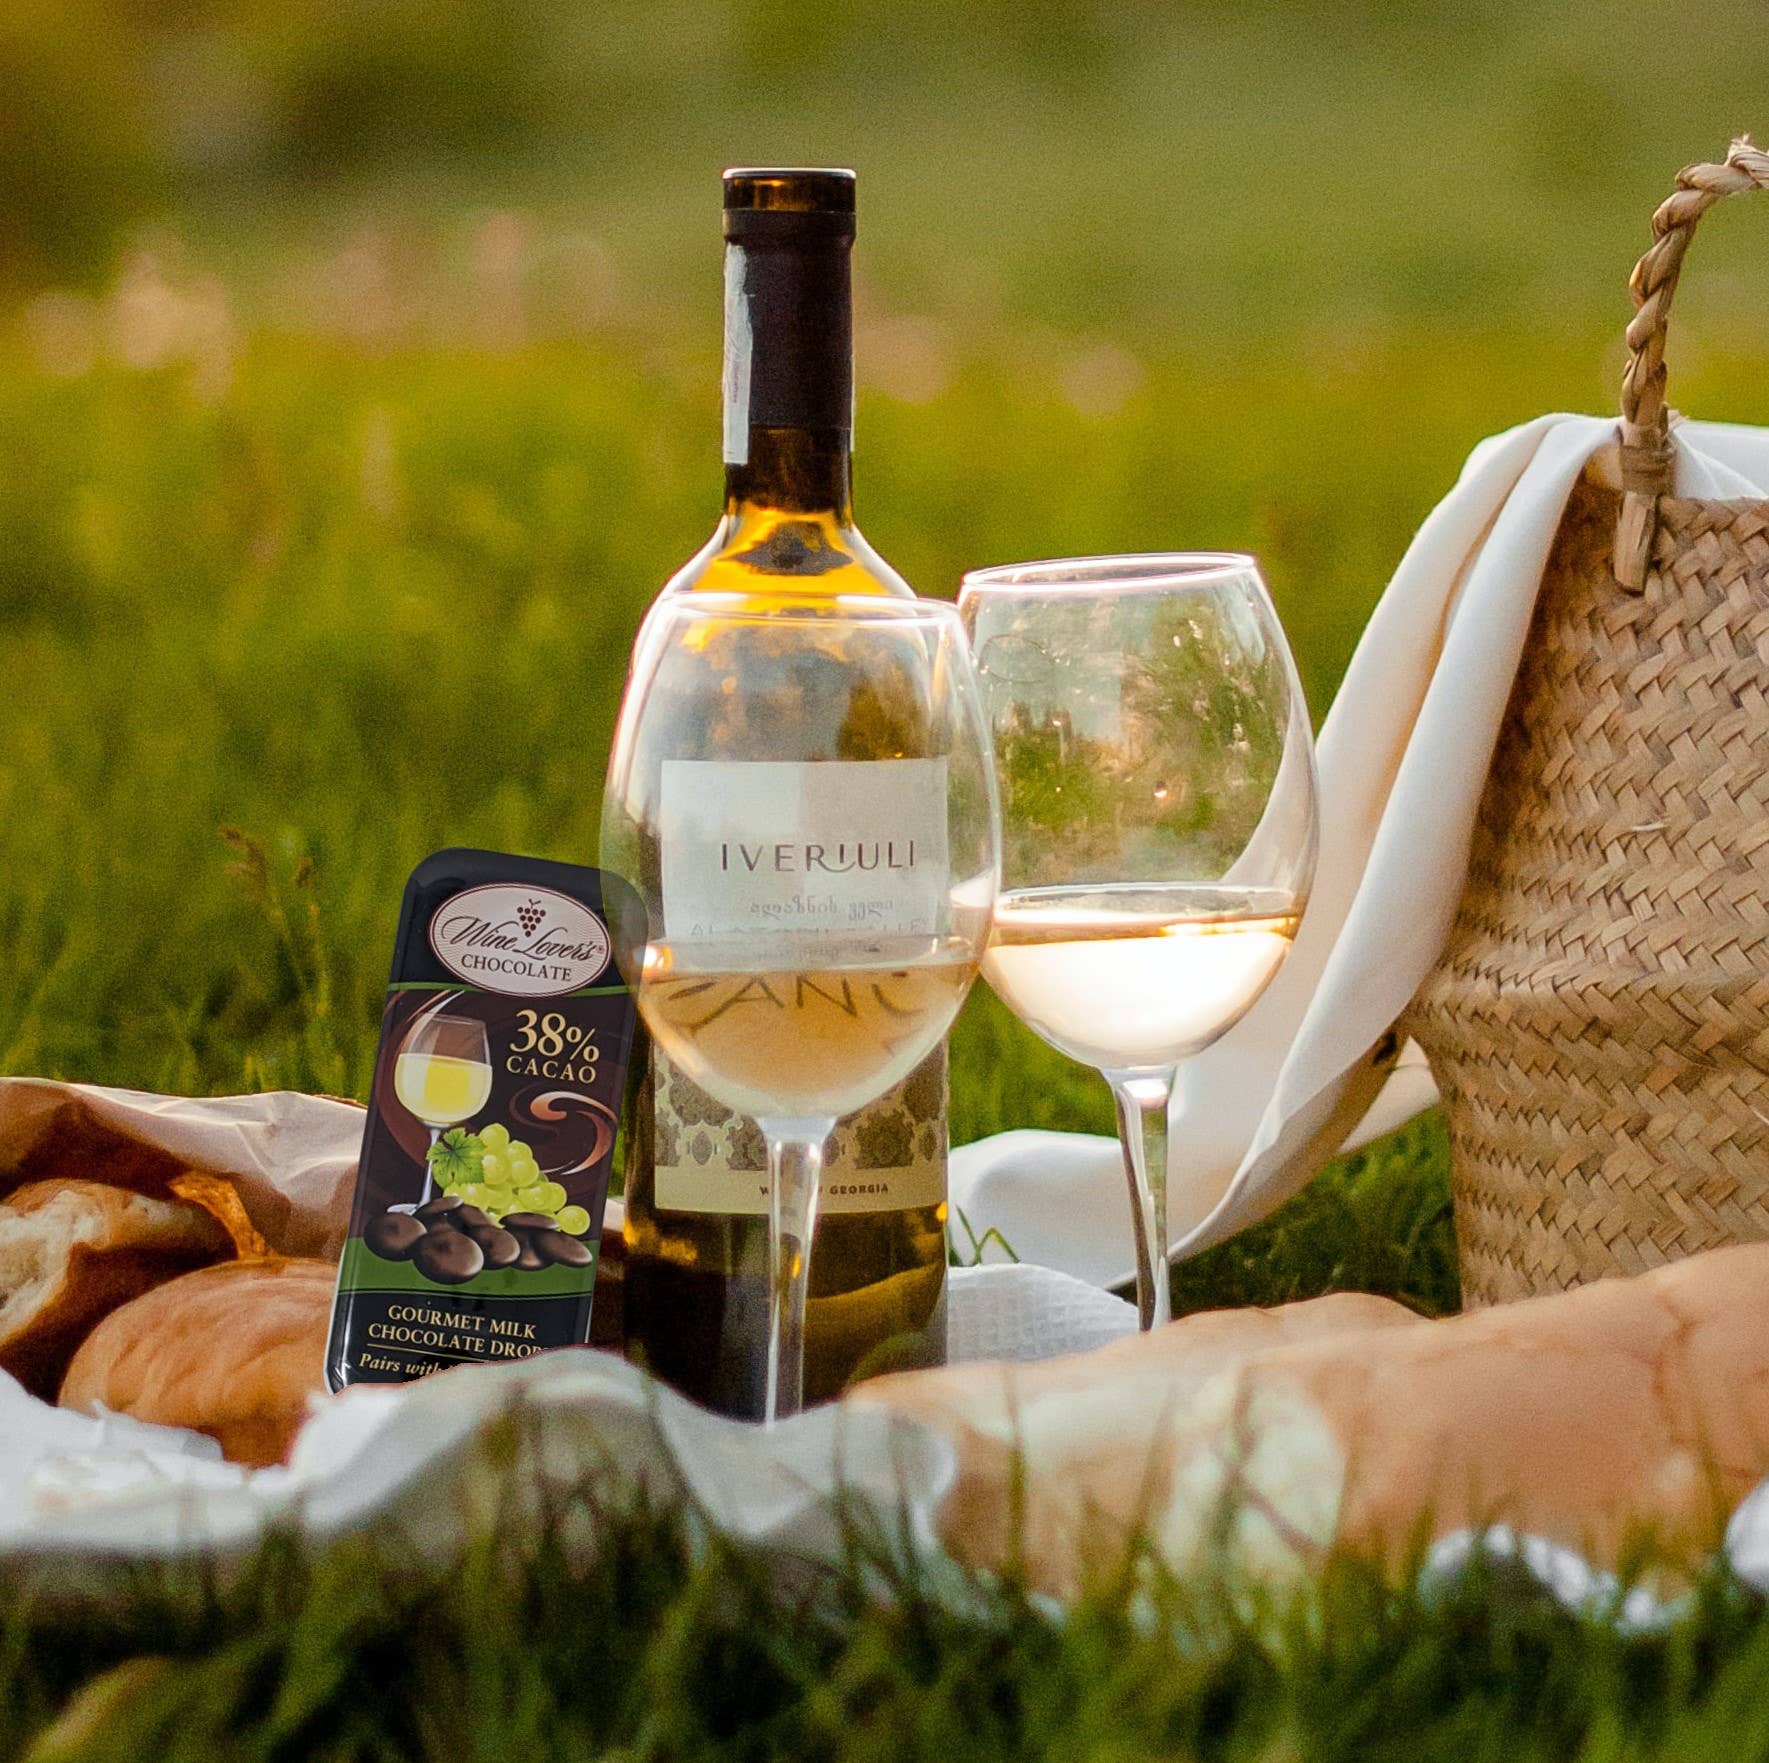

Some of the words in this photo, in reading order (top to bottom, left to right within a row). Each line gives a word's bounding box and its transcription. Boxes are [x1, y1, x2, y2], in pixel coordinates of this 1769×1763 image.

[721, 840, 915, 873] IVERIULI
[440, 915, 519, 950] Wine
[511, 926, 597, 962] Lover's
[460, 953, 572, 982] CHOCOLATE
[509, 1008, 600, 1063] 38%
[506, 1055, 596, 1084] CACAO
[829, 1183, 889, 1195] GEORGIA
[387, 1304, 485, 1332] GOURMET
[489, 1318, 537, 1340] MILK
[367, 1322, 485, 1354] CHOCOLATE
[489, 1339, 552, 1359] DRO
[359, 1353, 401, 1372] Pairs
